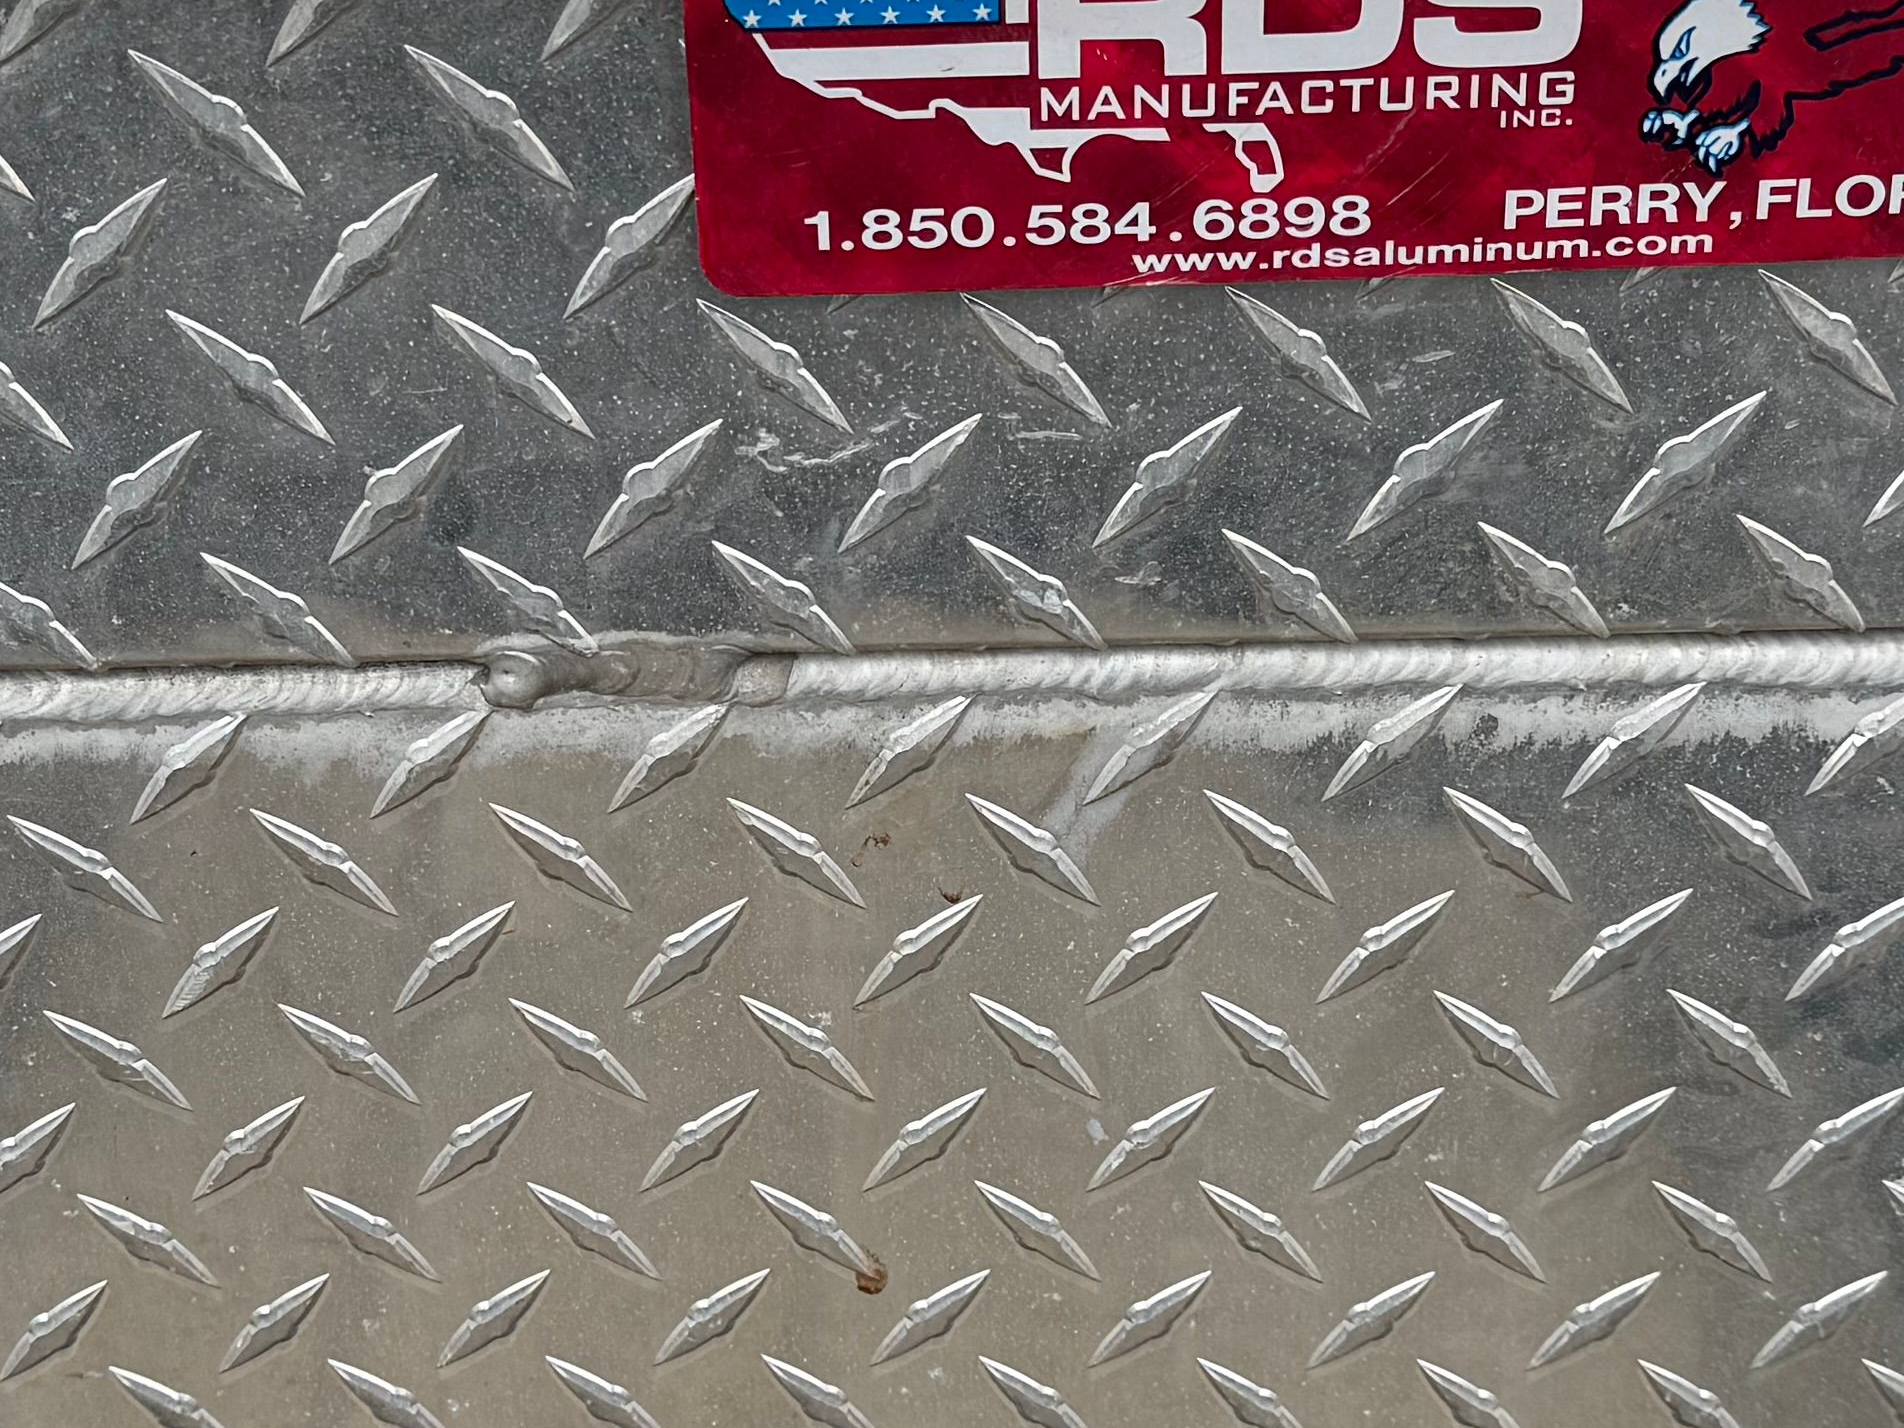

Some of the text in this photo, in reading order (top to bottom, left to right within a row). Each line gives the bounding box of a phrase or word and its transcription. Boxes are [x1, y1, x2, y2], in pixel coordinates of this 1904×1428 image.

[1039, 70, 1577, 122] MANUFACTURING
[1499, 108, 1575, 129] INC.
[803, 194, 1372, 251] 1.850.584.6898
[1131, 234, 1713, 273] www.rdsaluminum.com
